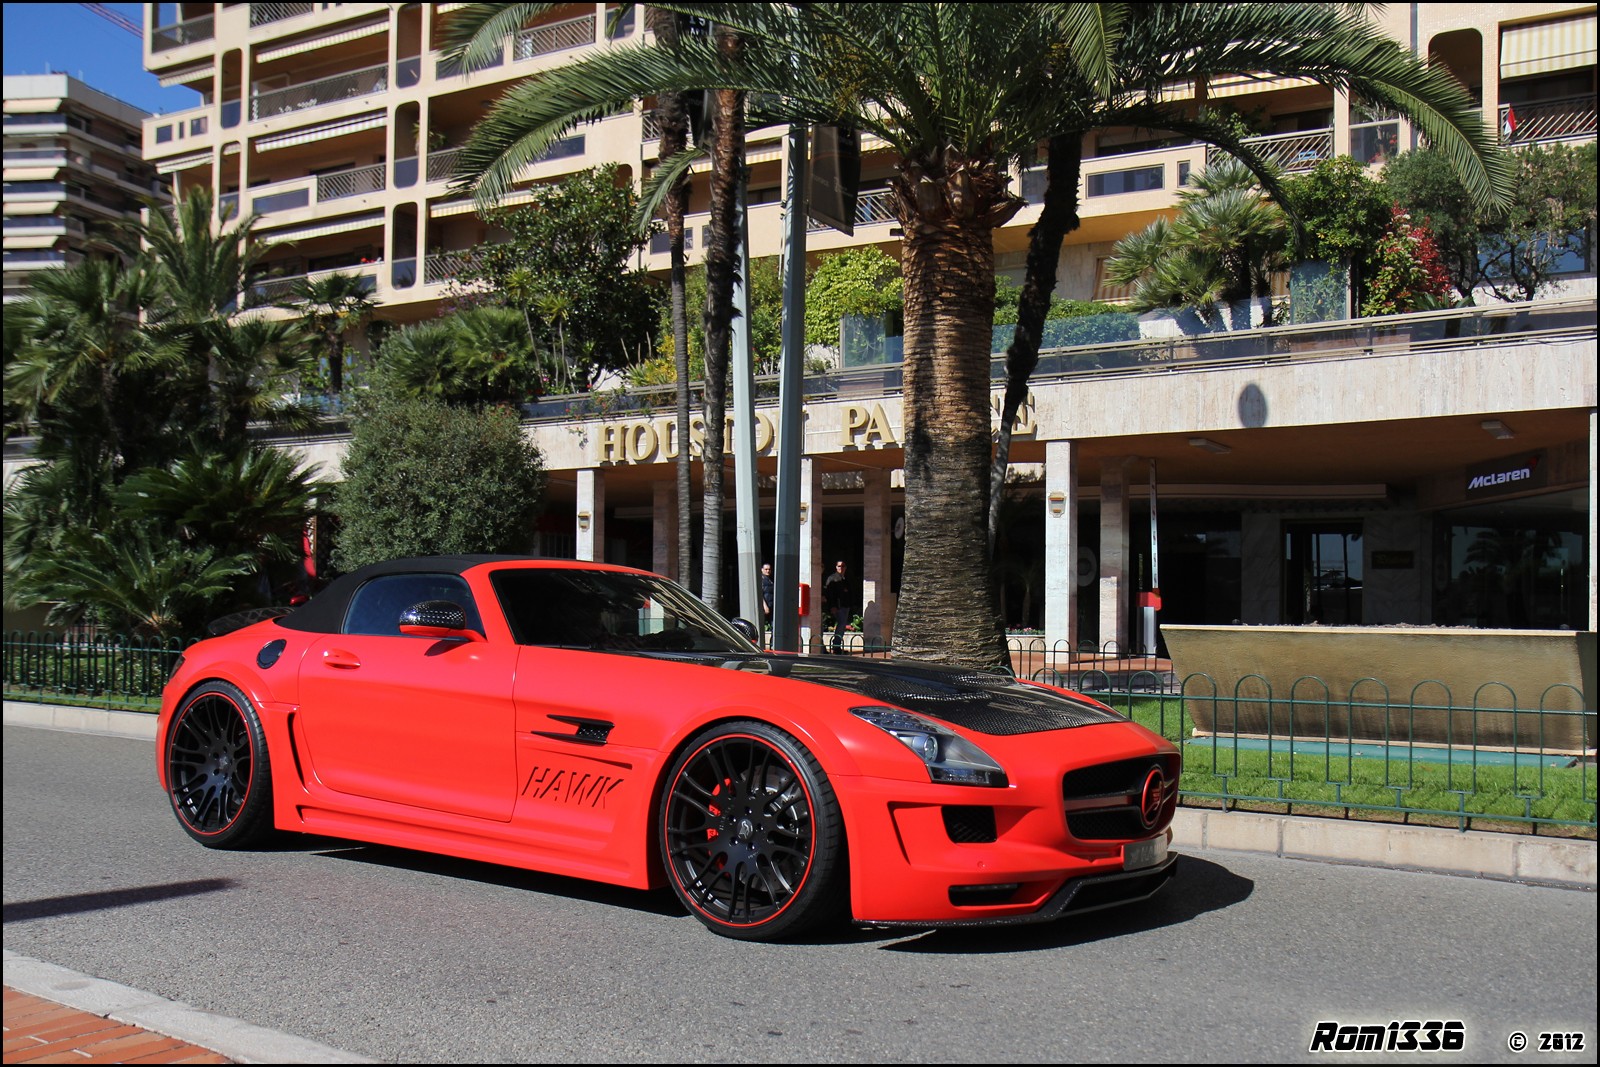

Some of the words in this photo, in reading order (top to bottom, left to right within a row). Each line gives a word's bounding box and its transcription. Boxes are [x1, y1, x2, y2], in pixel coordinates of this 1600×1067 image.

[597, 410, 781, 462] HOUSTO
[839, 391, 1035, 446] PAE
[1468, 467, 1530, 490] McLaren
[521, 766, 625, 809] HAWK
